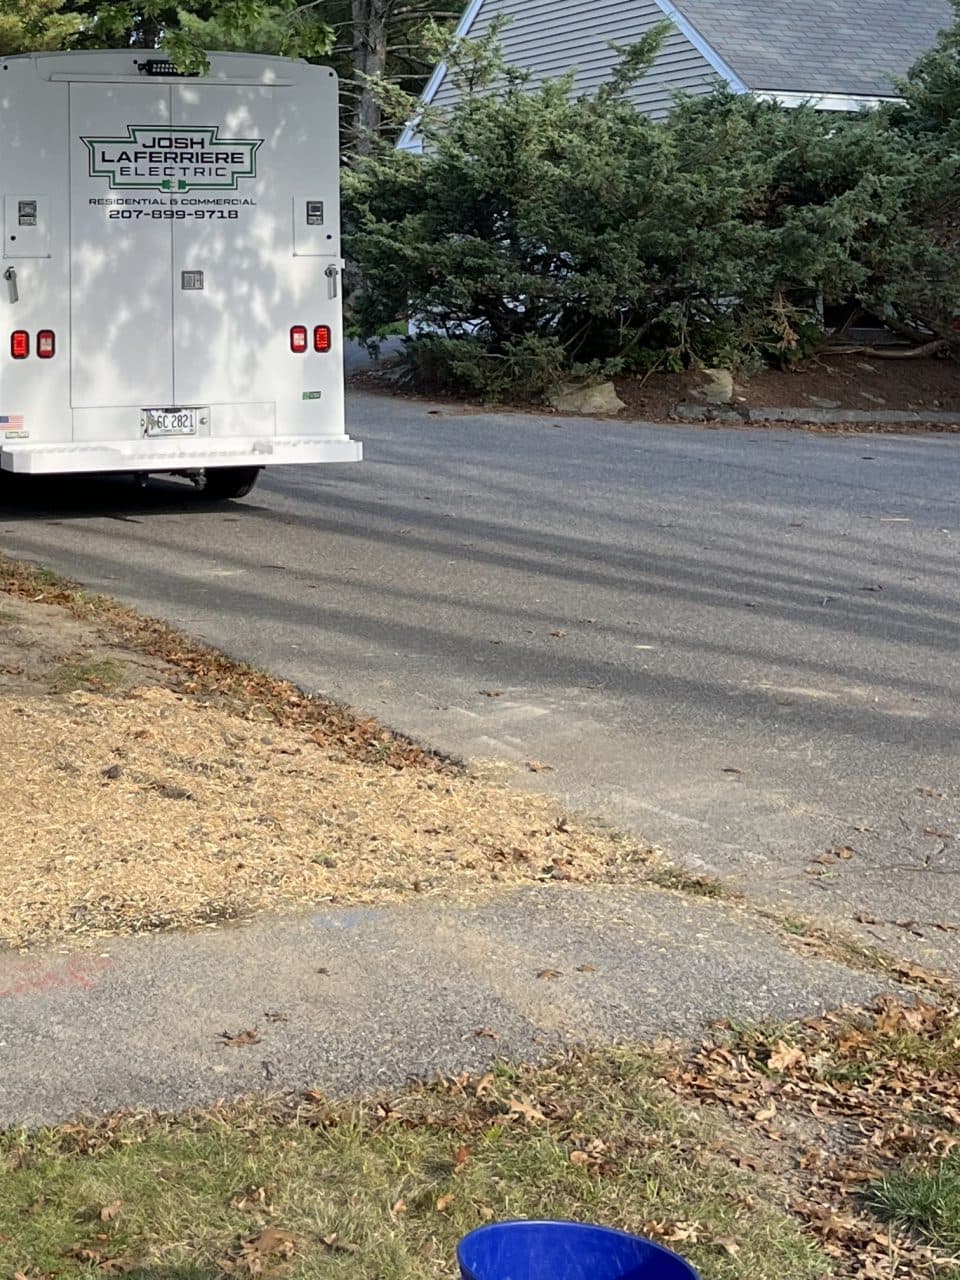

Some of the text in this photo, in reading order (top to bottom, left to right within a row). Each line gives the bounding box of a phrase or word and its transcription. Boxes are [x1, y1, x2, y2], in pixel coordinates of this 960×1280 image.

[142, 137, 205, 150] JOSH
[101, 151, 245, 164] LAFERRIERE
[119, 166, 228, 177] ELECTRIC
[88, 198, 166, 206] RESIDENTIAL
[180, 198, 257, 206] COMMERCIAL
[109, 210, 239, 219] 207-899-9718
